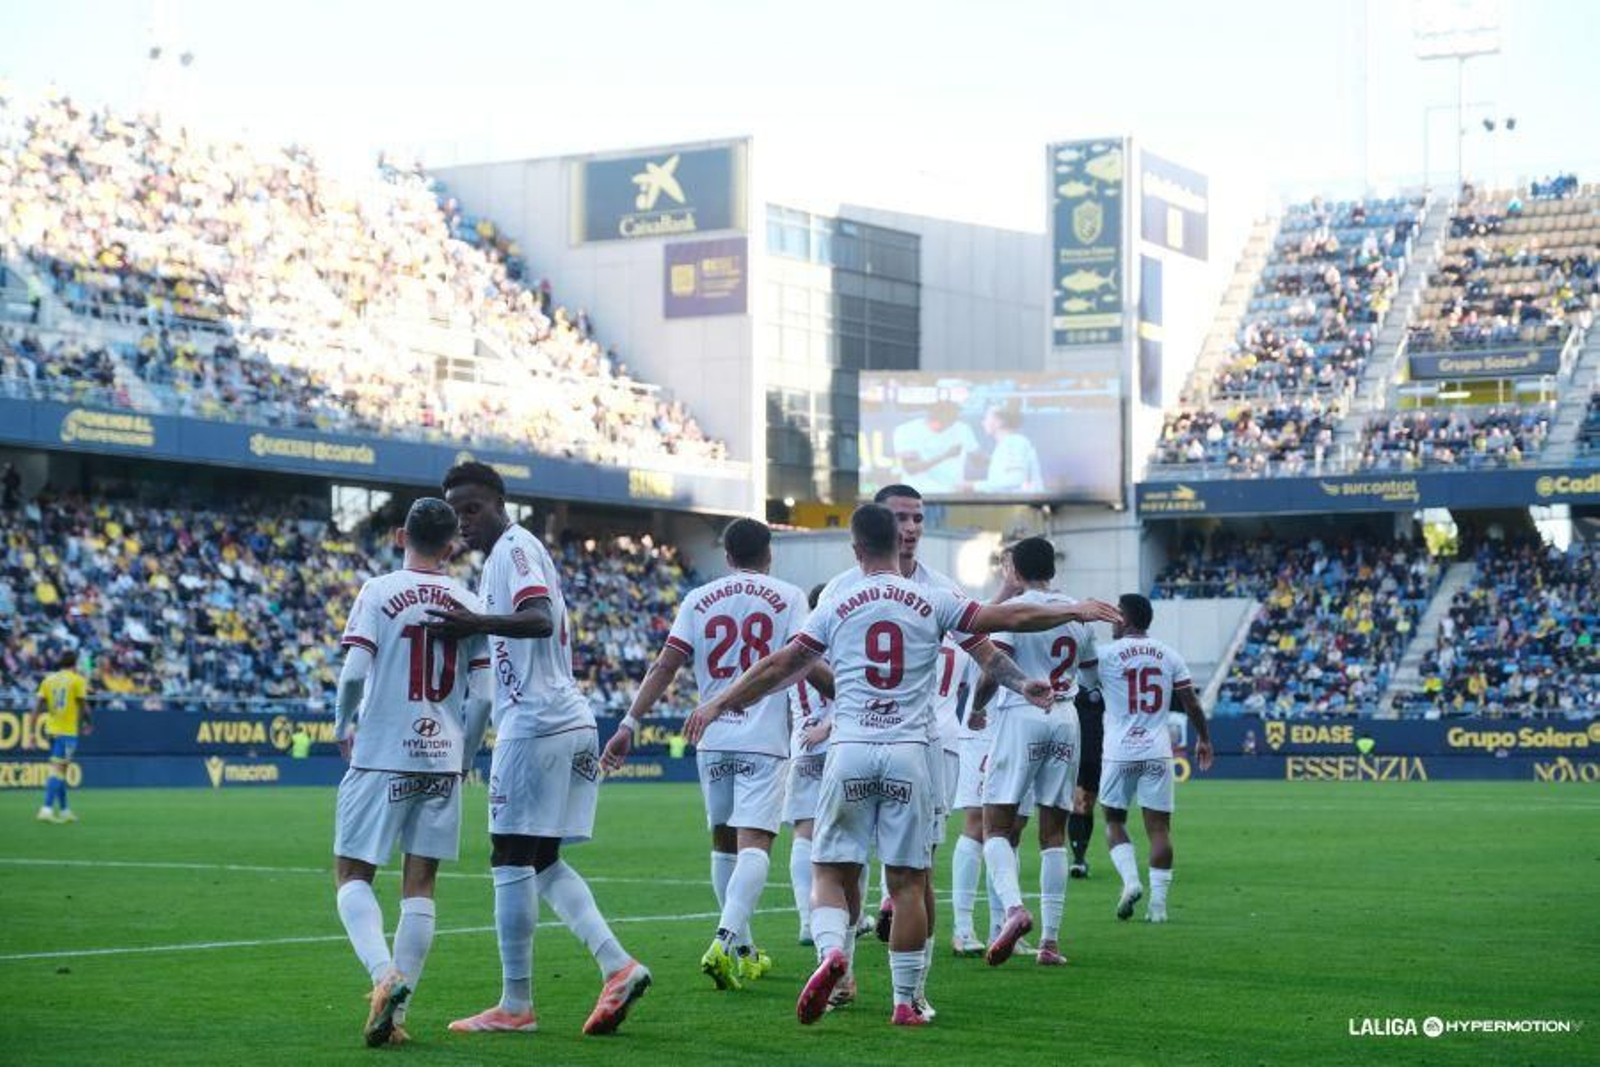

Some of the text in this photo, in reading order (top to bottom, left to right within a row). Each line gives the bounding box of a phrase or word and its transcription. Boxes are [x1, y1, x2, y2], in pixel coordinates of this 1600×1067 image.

[401, 624, 458, 703] 10
[704, 611, 774, 680] 28
[864, 620, 904, 690] 9
[1122, 666, 1163, 715] 15
[197, 721, 267, 743] AYUDA
[1291, 725, 1354, 744] EDASE
[1447, 726, 1589, 753] Grupo Solera
